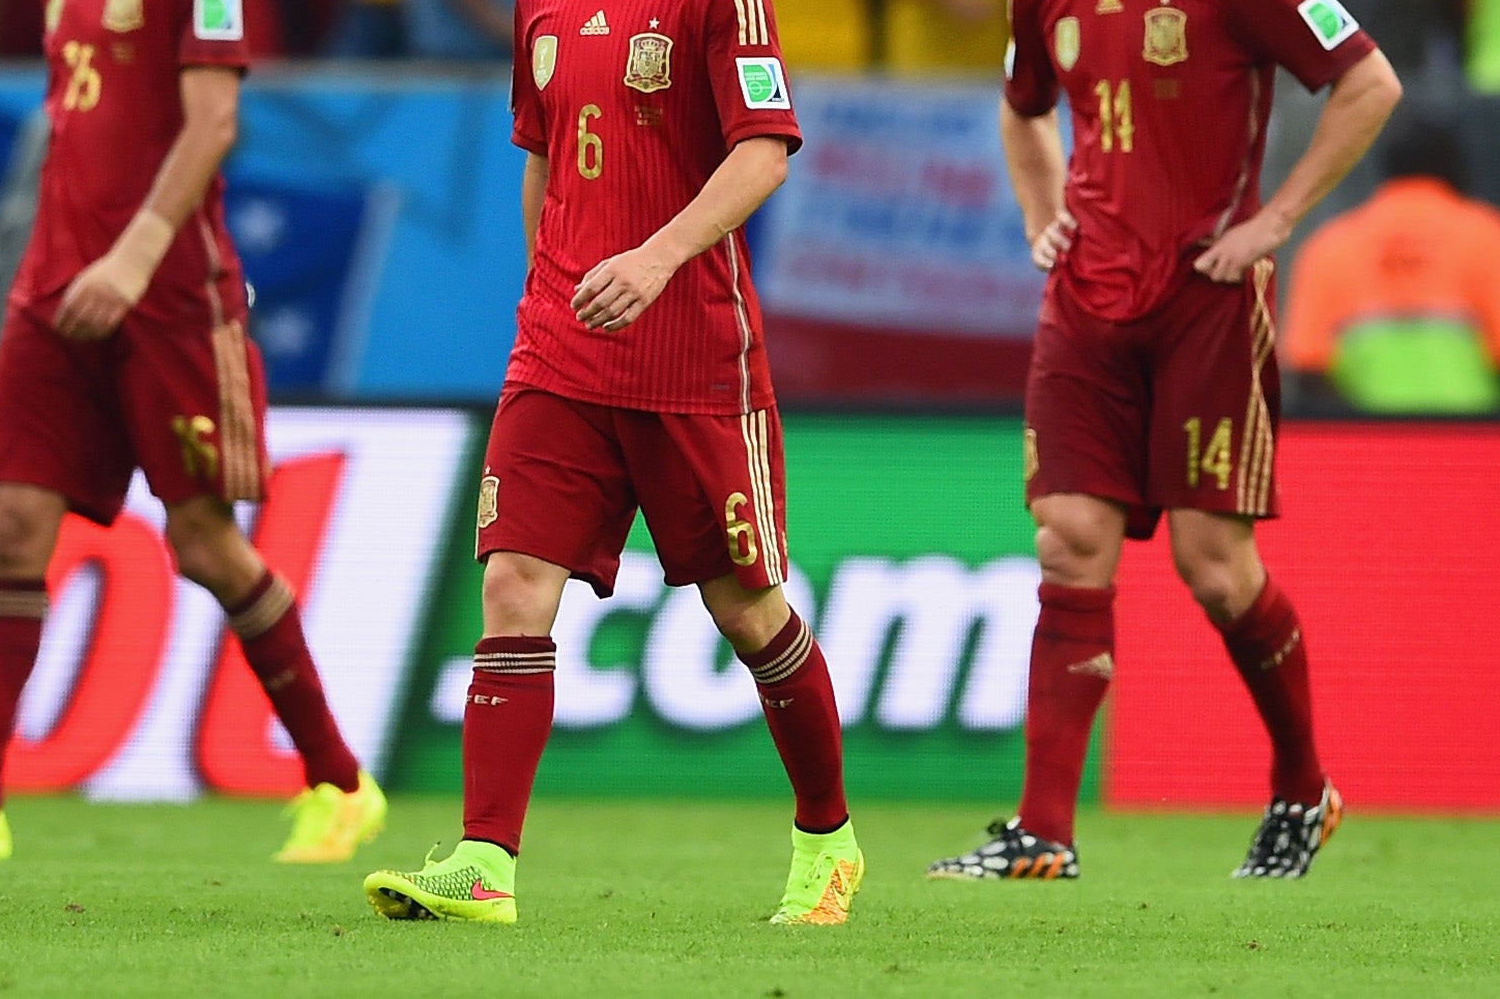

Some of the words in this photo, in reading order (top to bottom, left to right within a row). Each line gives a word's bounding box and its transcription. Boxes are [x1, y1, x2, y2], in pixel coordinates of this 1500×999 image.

[577, 103, 603, 180] 6
[1094, 78, 1135, 153] 14
[1183, 416, 1234, 490] 14
[724, 491, 758, 567] 6
[429, 553, 1044, 730] .com
